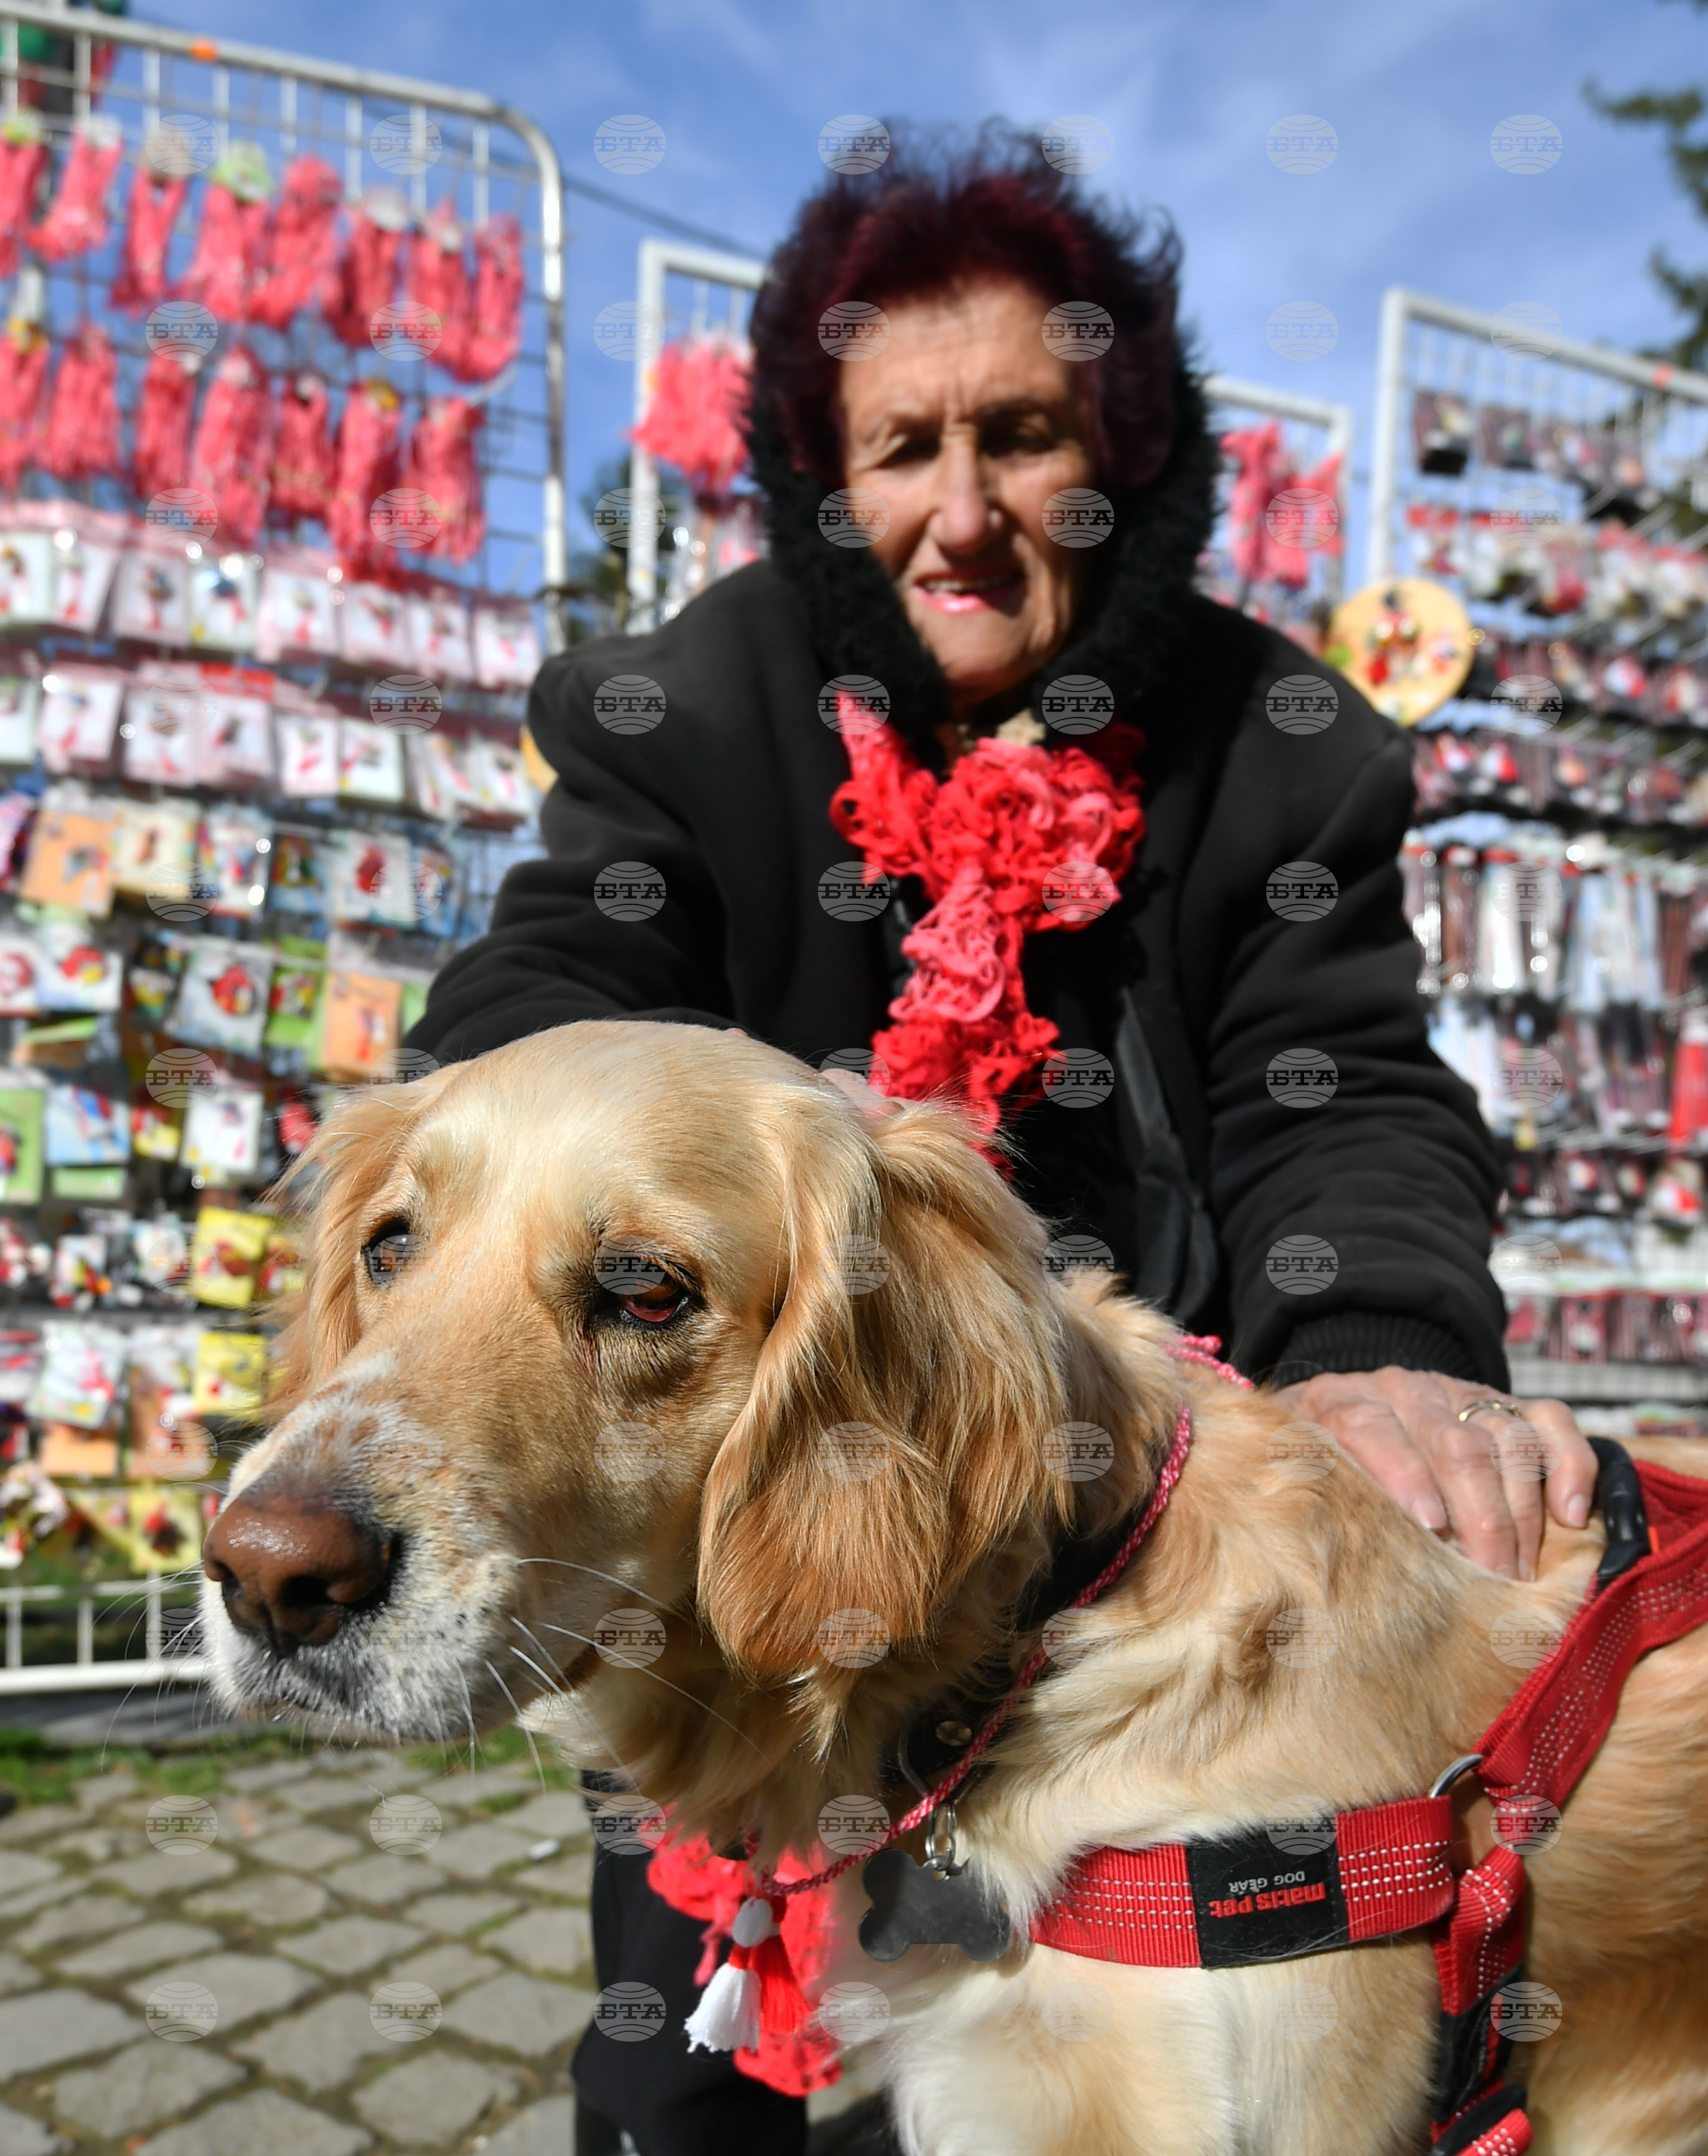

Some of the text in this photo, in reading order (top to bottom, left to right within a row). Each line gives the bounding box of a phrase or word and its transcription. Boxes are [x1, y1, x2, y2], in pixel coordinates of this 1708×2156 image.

[1228, 1871, 1305, 1893] DOG GEAR
[1208, 1882, 1326, 1918] matis pet
